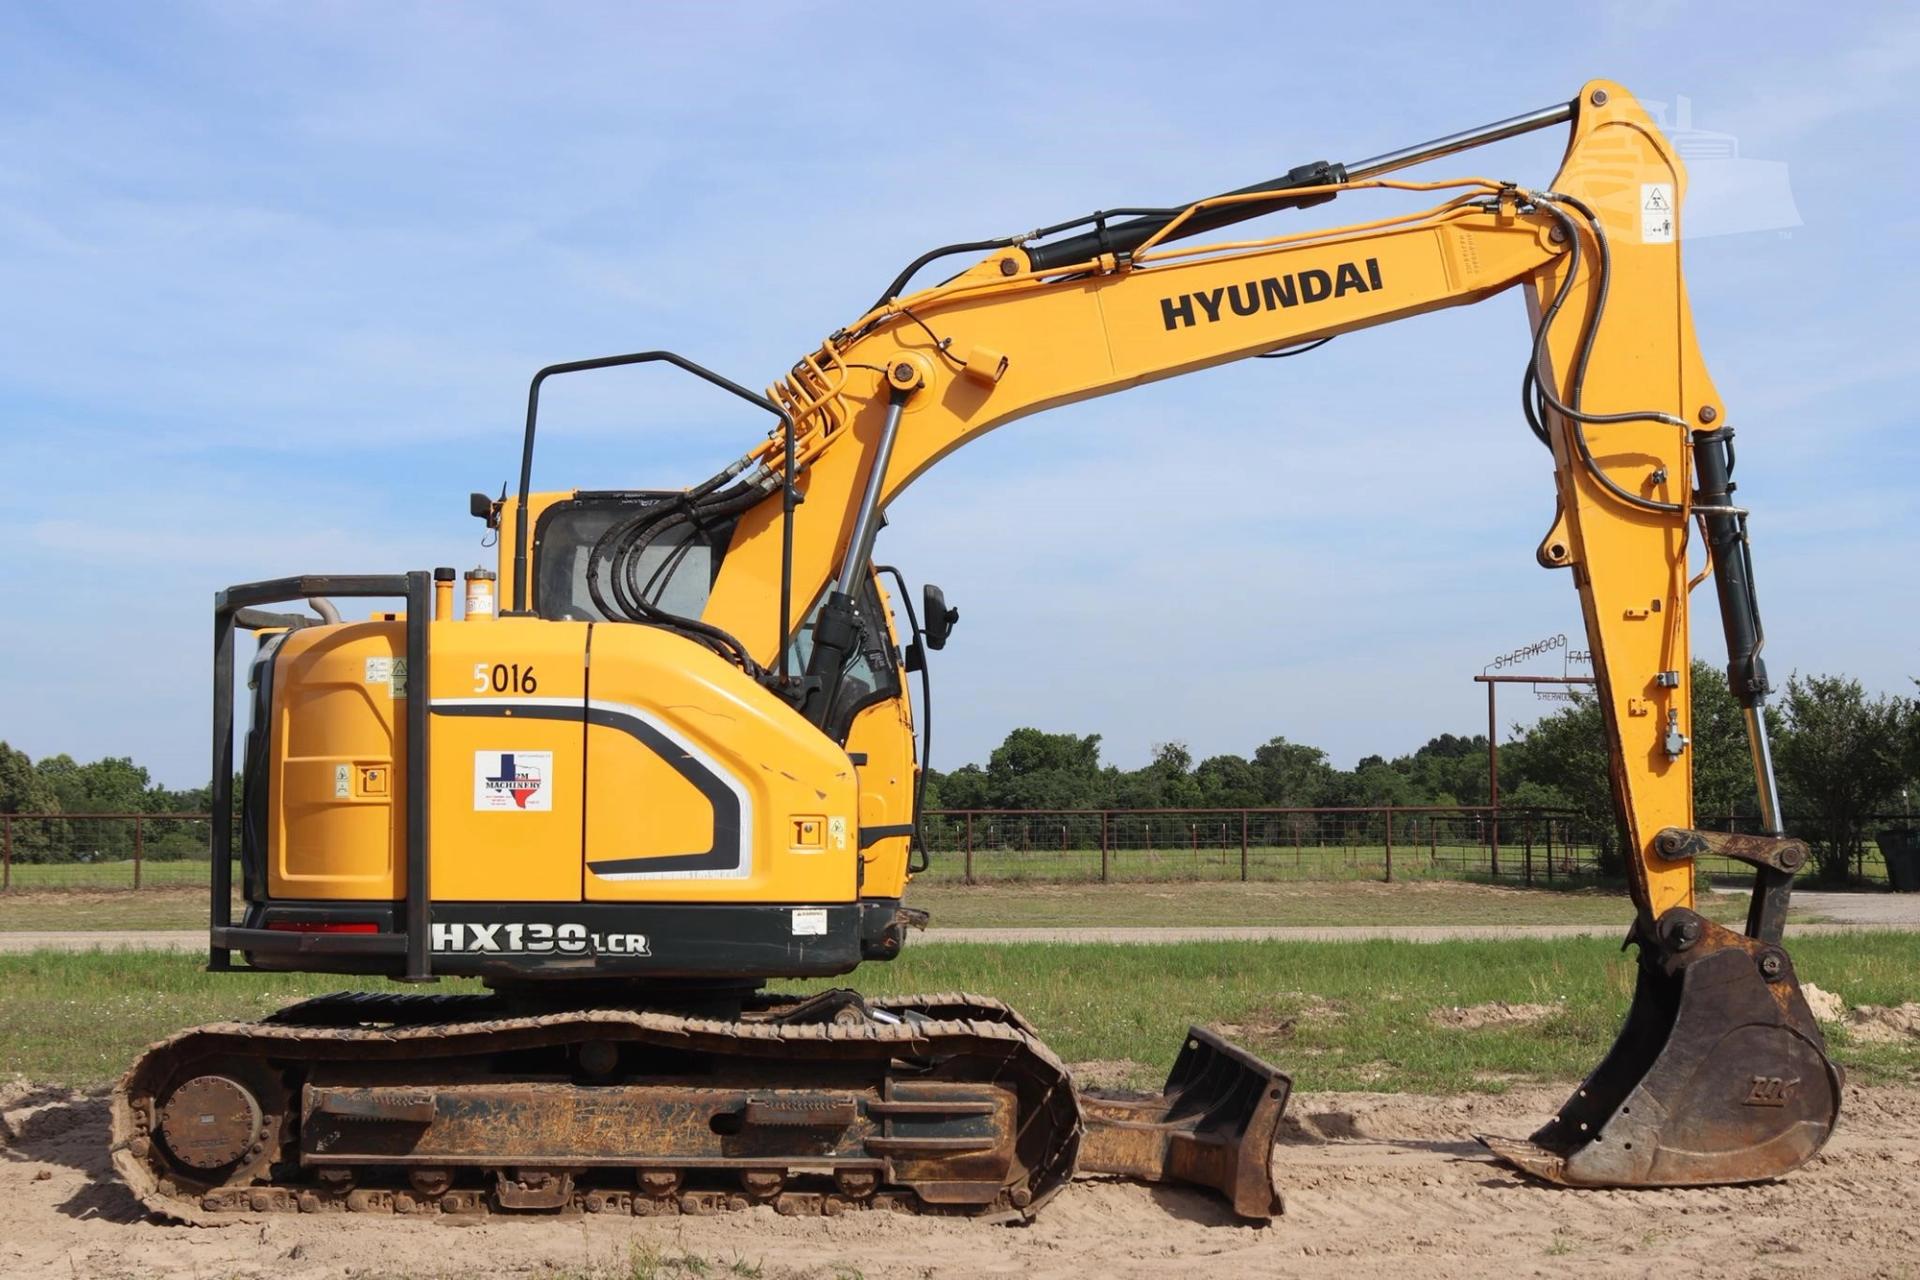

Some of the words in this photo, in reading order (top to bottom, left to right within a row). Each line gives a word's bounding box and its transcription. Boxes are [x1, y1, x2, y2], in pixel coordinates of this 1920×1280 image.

[1160, 258, 1383, 331] HYUNDAI
[1494, 634, 1566, 669] SHERWOOD
[1568, 651, 1592, 664] FAR
[473, 663, 537, 694] 5016
